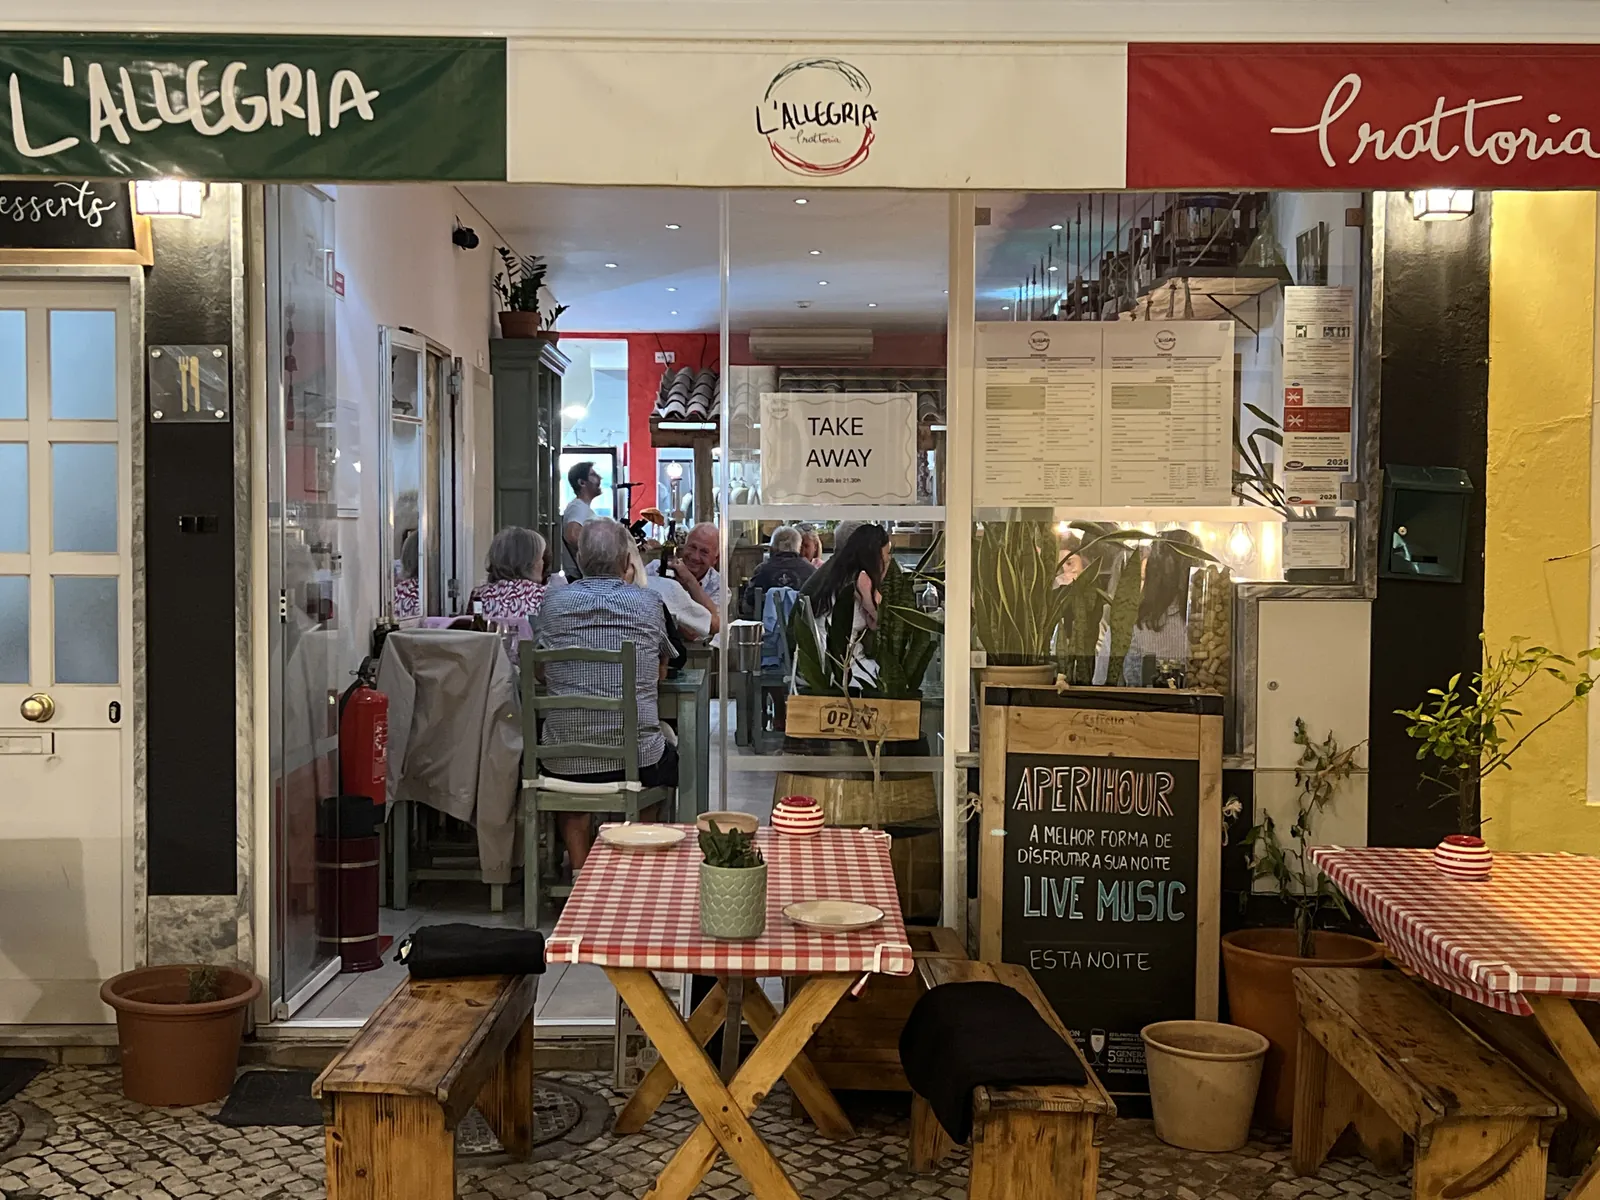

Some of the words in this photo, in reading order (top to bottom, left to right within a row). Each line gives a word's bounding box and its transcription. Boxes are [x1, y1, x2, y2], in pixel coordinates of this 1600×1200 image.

[8, 56, 380, 158] L'ALLEGRIA
[756, 100, 879, 135] L'ALLEGRIA
[808, 417, 864, 436] TAKE
[806, 448, 872, 467] AWAY
[827, 710, 875, 731] OPEN
[1029, 824, 1039, 843] A
[1044, 826, 1095, 847] MELHOR
[1100, 829, 1149, 848] FORMA
[1155, 833, 1173, 848] DE
[1091, 854, 1101, 869] A
[1103, 855, 1128, 871] SUA
[1023, 875, 1085, 920] LIVE
[1096, 879, 1186, 922] MUSIC
[1030, 949, 1082, 970] ESTA
[1107, 1050, 1116, 1063] 5
